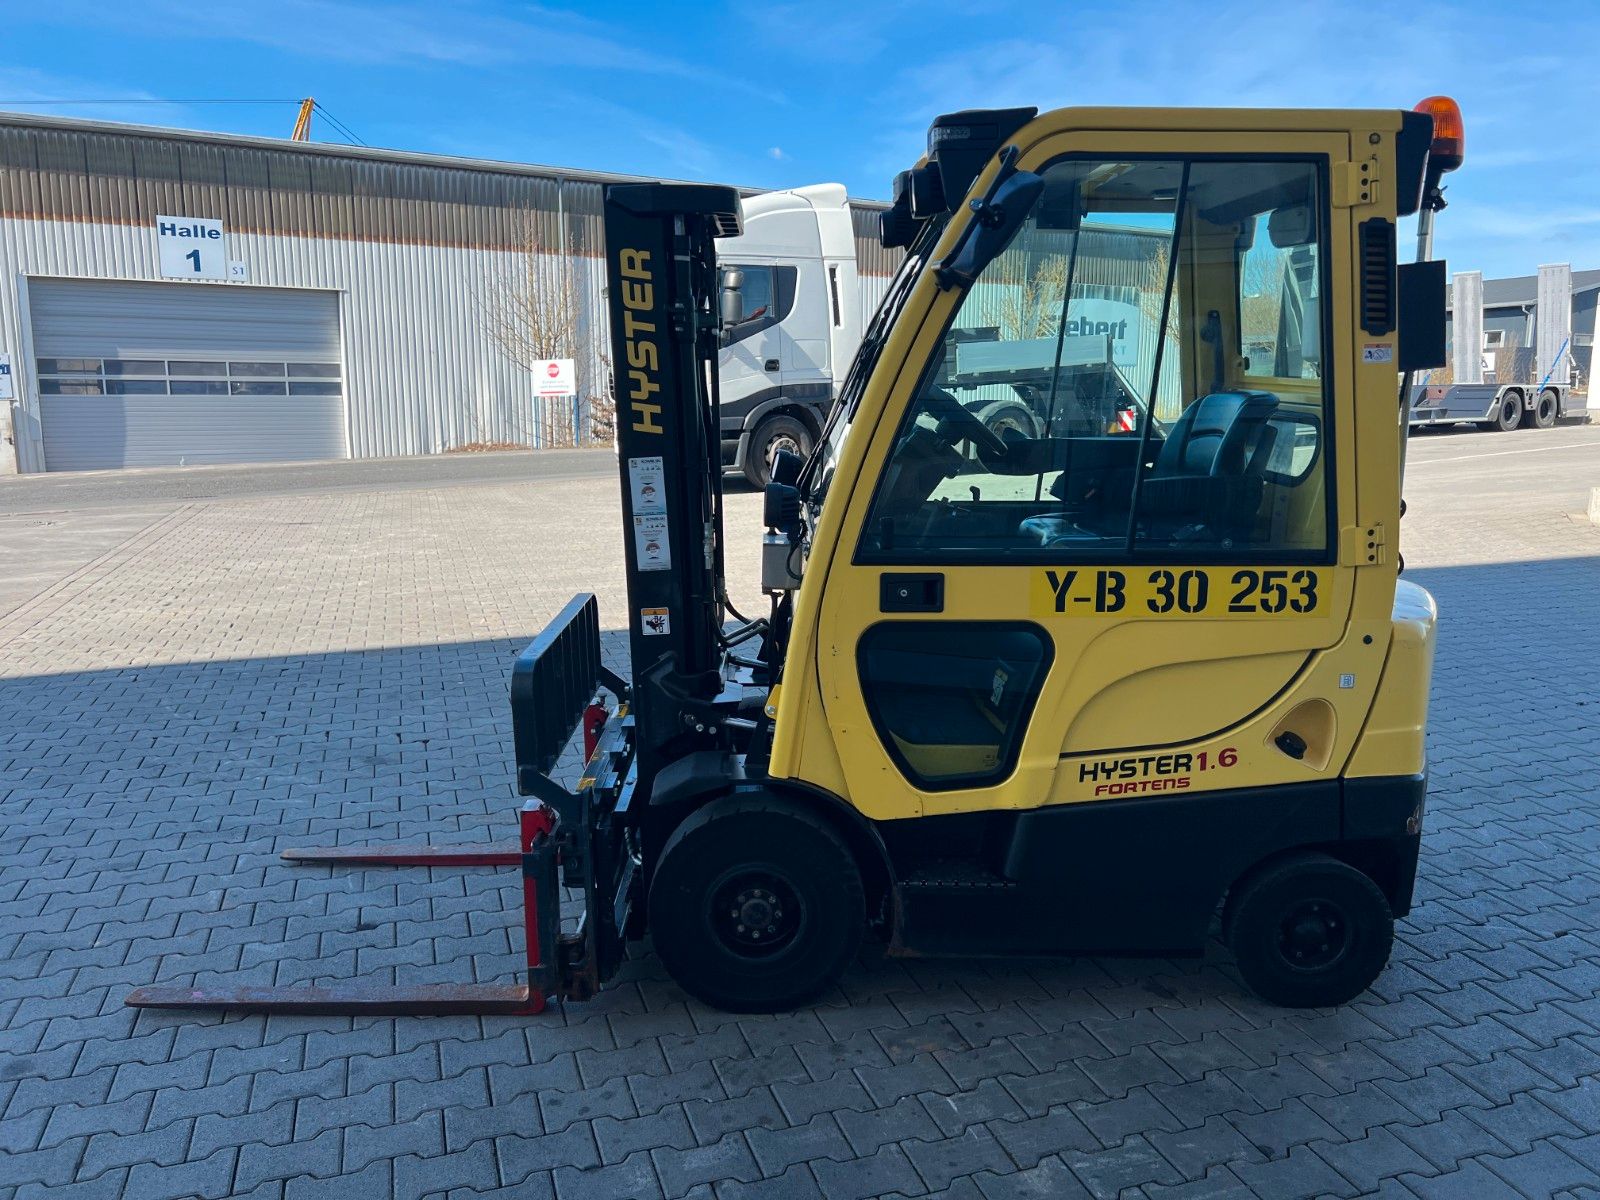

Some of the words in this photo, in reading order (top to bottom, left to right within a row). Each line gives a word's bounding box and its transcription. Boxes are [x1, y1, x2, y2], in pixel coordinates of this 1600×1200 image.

[160, 222, 220, 239] Halle
[185, 249, 202, 272] 1
[1050, 315, 1127, 339] ebert
[619, 248, 664, 434] HYSTER
[1045, 570, 1126, 613] Y-B
[1146, 570, 1208, 613] 30
[1228, 570, 1318, 613] 253
[1079, 753, 1193, 783] HYSTER
[1196, 747, 1238, 771] 1.6
[1094, 777, 1190, 797] FORTENS
